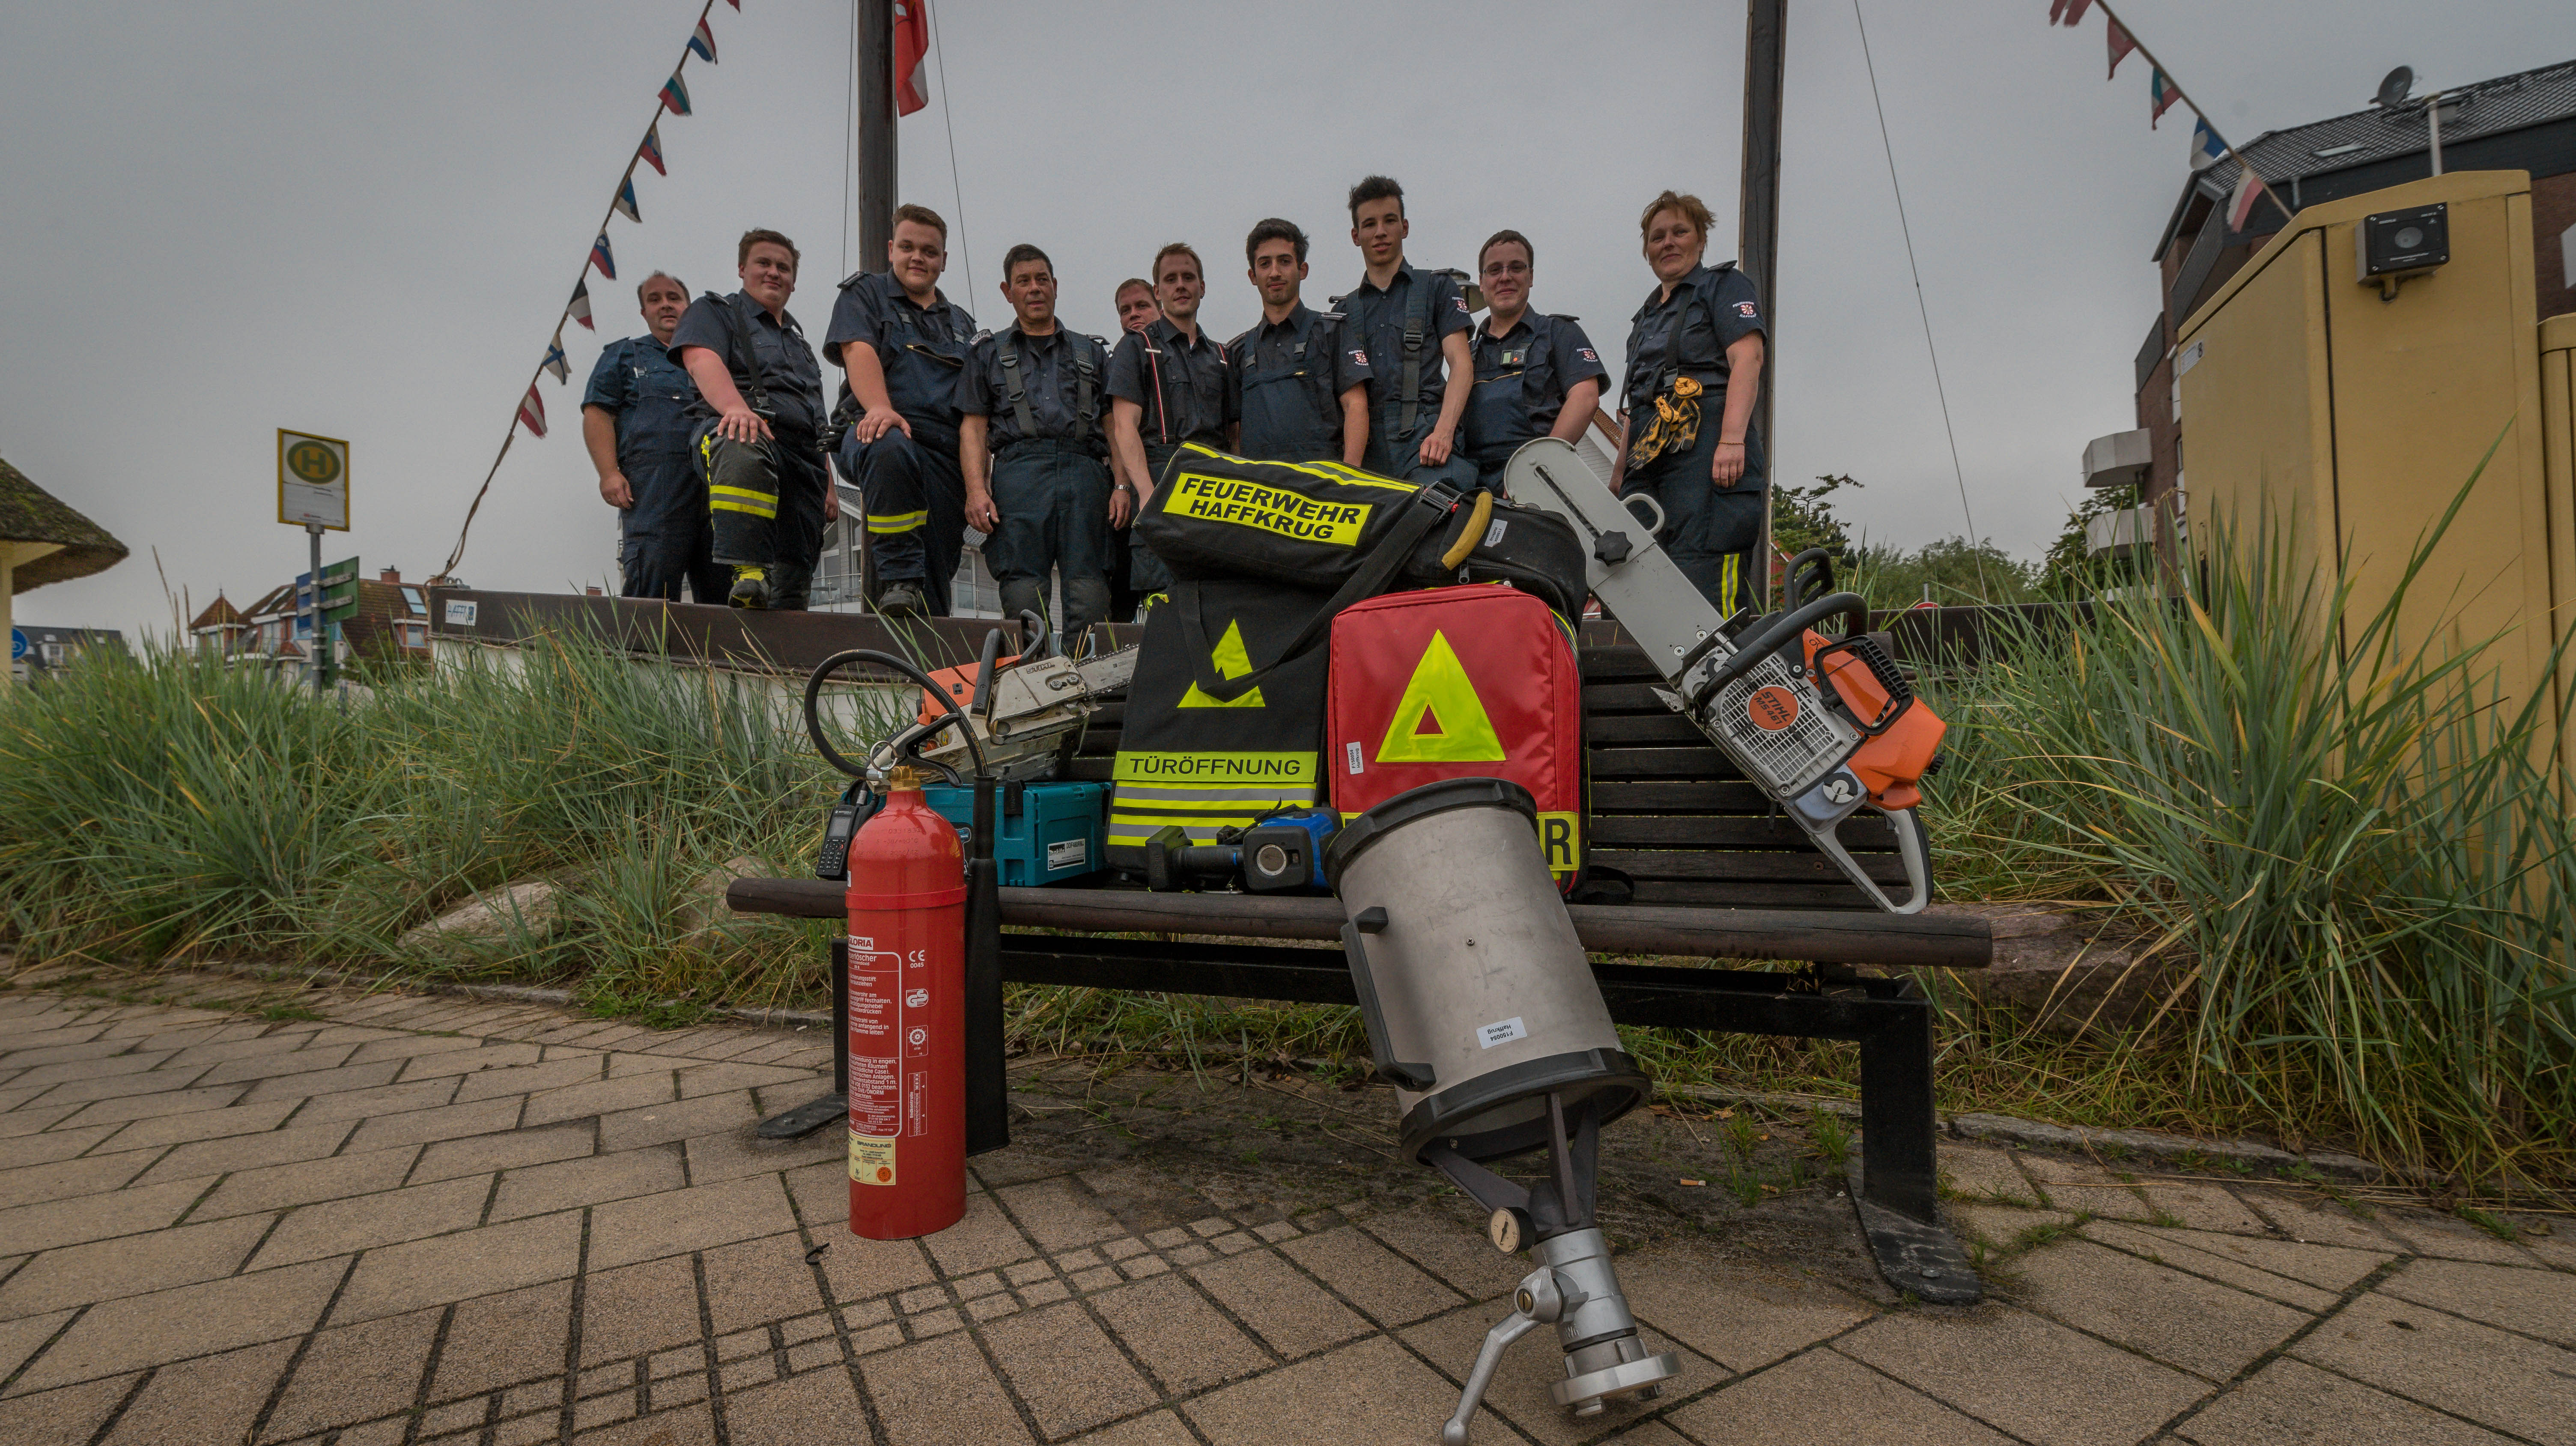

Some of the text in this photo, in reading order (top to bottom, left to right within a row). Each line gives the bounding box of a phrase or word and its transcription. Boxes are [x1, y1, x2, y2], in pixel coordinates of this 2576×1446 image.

[2198, 342, 2203, 358] 8
[301, 449, 326, 475] H
[1181, 478, 1361, 524] FEUERWEHR
[1189, 499, 1334, 539] HAFFKRUG
[1489, 527, 1498, 541] Haffkrug
[1026, 662, 1055, 674] STIHL
[1761, 691, 1791, 722] STIHL
[1767, 711, 1783, 724] 461
[1130, 756, 1300, 775] TÜRÖFFNUNG
[1049, 847, 1065, 857] makita
[848, 937, 872, 947] GLORIA
[848, 952, 877, 962] euerlöscher
[1487, 1024, 1512, 1034] Haffkrug
[1490, 1031, 1513, 1042] F150054
